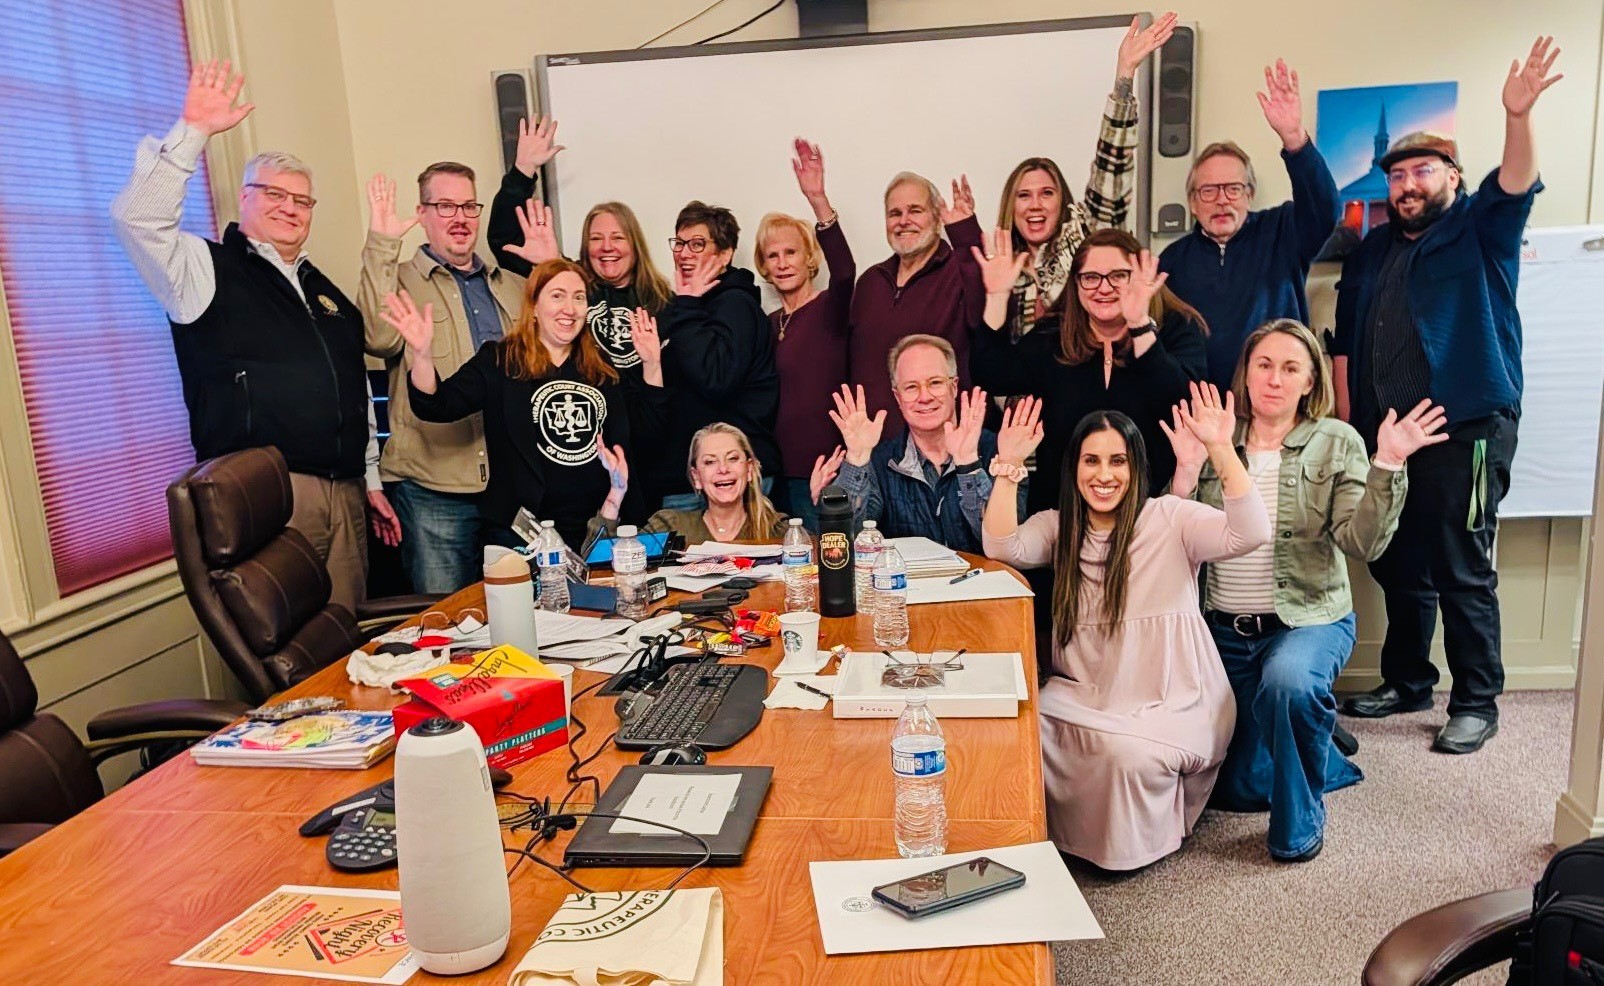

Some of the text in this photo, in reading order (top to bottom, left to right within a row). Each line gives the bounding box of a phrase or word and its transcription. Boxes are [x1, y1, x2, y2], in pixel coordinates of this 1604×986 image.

[576, 386, 604, 420] ASSOCIATION
[546, 445, 557, 455] OF
[822, 541, 846, 549] DEALER
[485, 741, 508, 756] PARTY
[511, 727, 546, 746] PLATTERS
[571, 889, 659, 937] ERAPEUTIC
[323, 919, 374, 949] Night
[336, 912, 403, 958] Recovery
